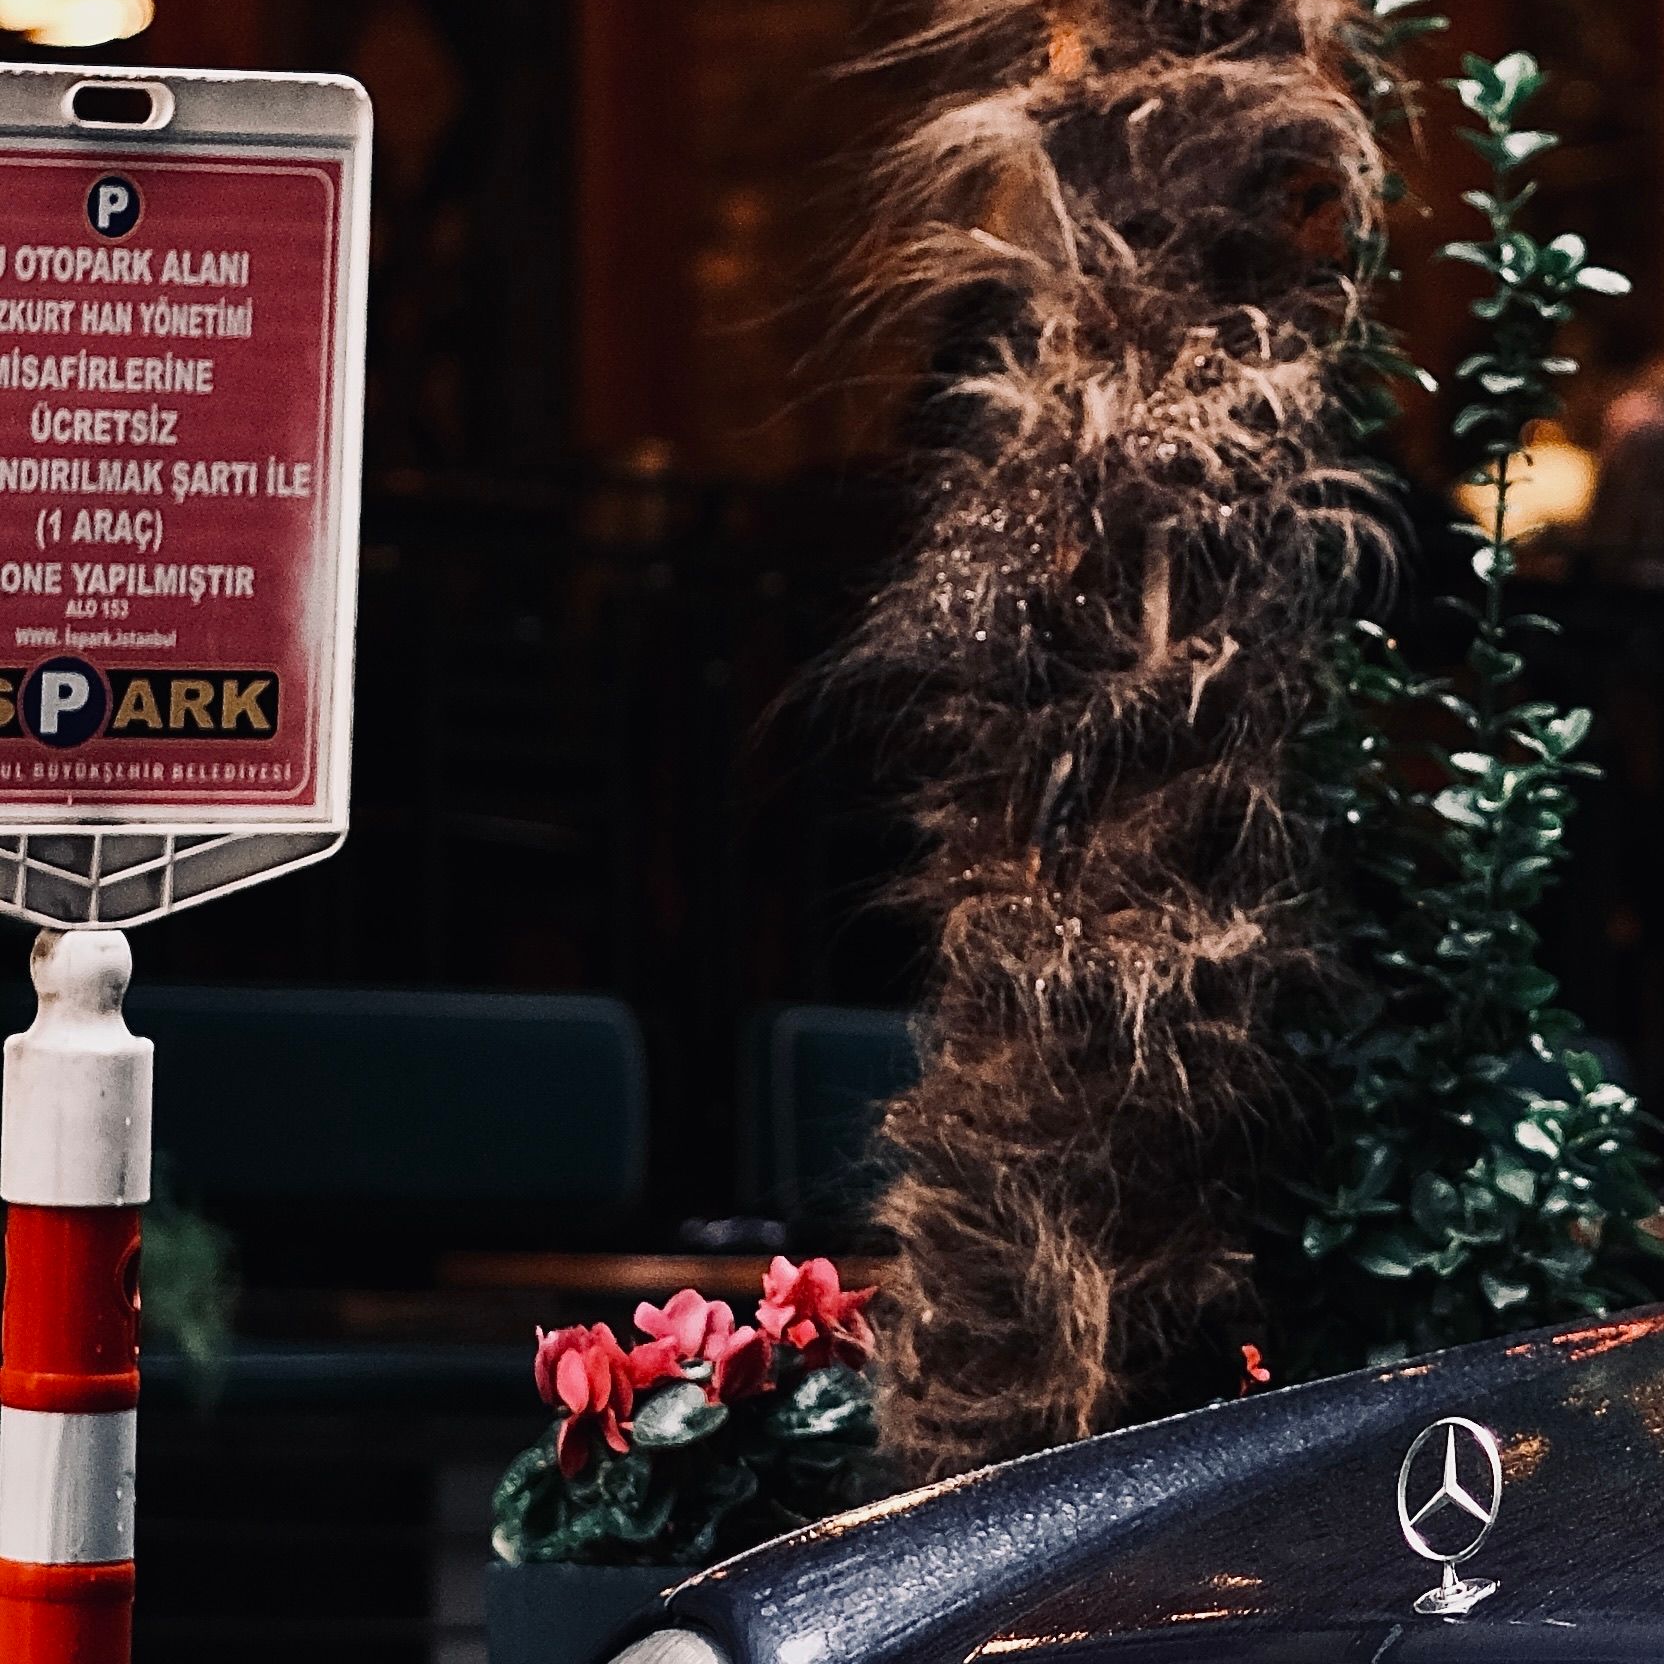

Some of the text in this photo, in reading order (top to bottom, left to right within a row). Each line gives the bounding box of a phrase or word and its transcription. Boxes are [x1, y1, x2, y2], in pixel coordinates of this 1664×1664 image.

[97, 185, 128, 229] P
[14, 244, 153, 285] OTOPARK
[159, 248, 249, 287] ALANI
[81, 300, 133, 336] HAN
[139, 295, 252, 340] YÖNETİMİ
[30, 400, 178, 446] ÜCRETSİZ
[172, 458, 258, 504] ŞARTI
[266, 455, 311, 498] İLE
[35, 507, 163, 554] (1 ARAÇ)
[70, 563, 255, 605] YAPILMIŞTIR
